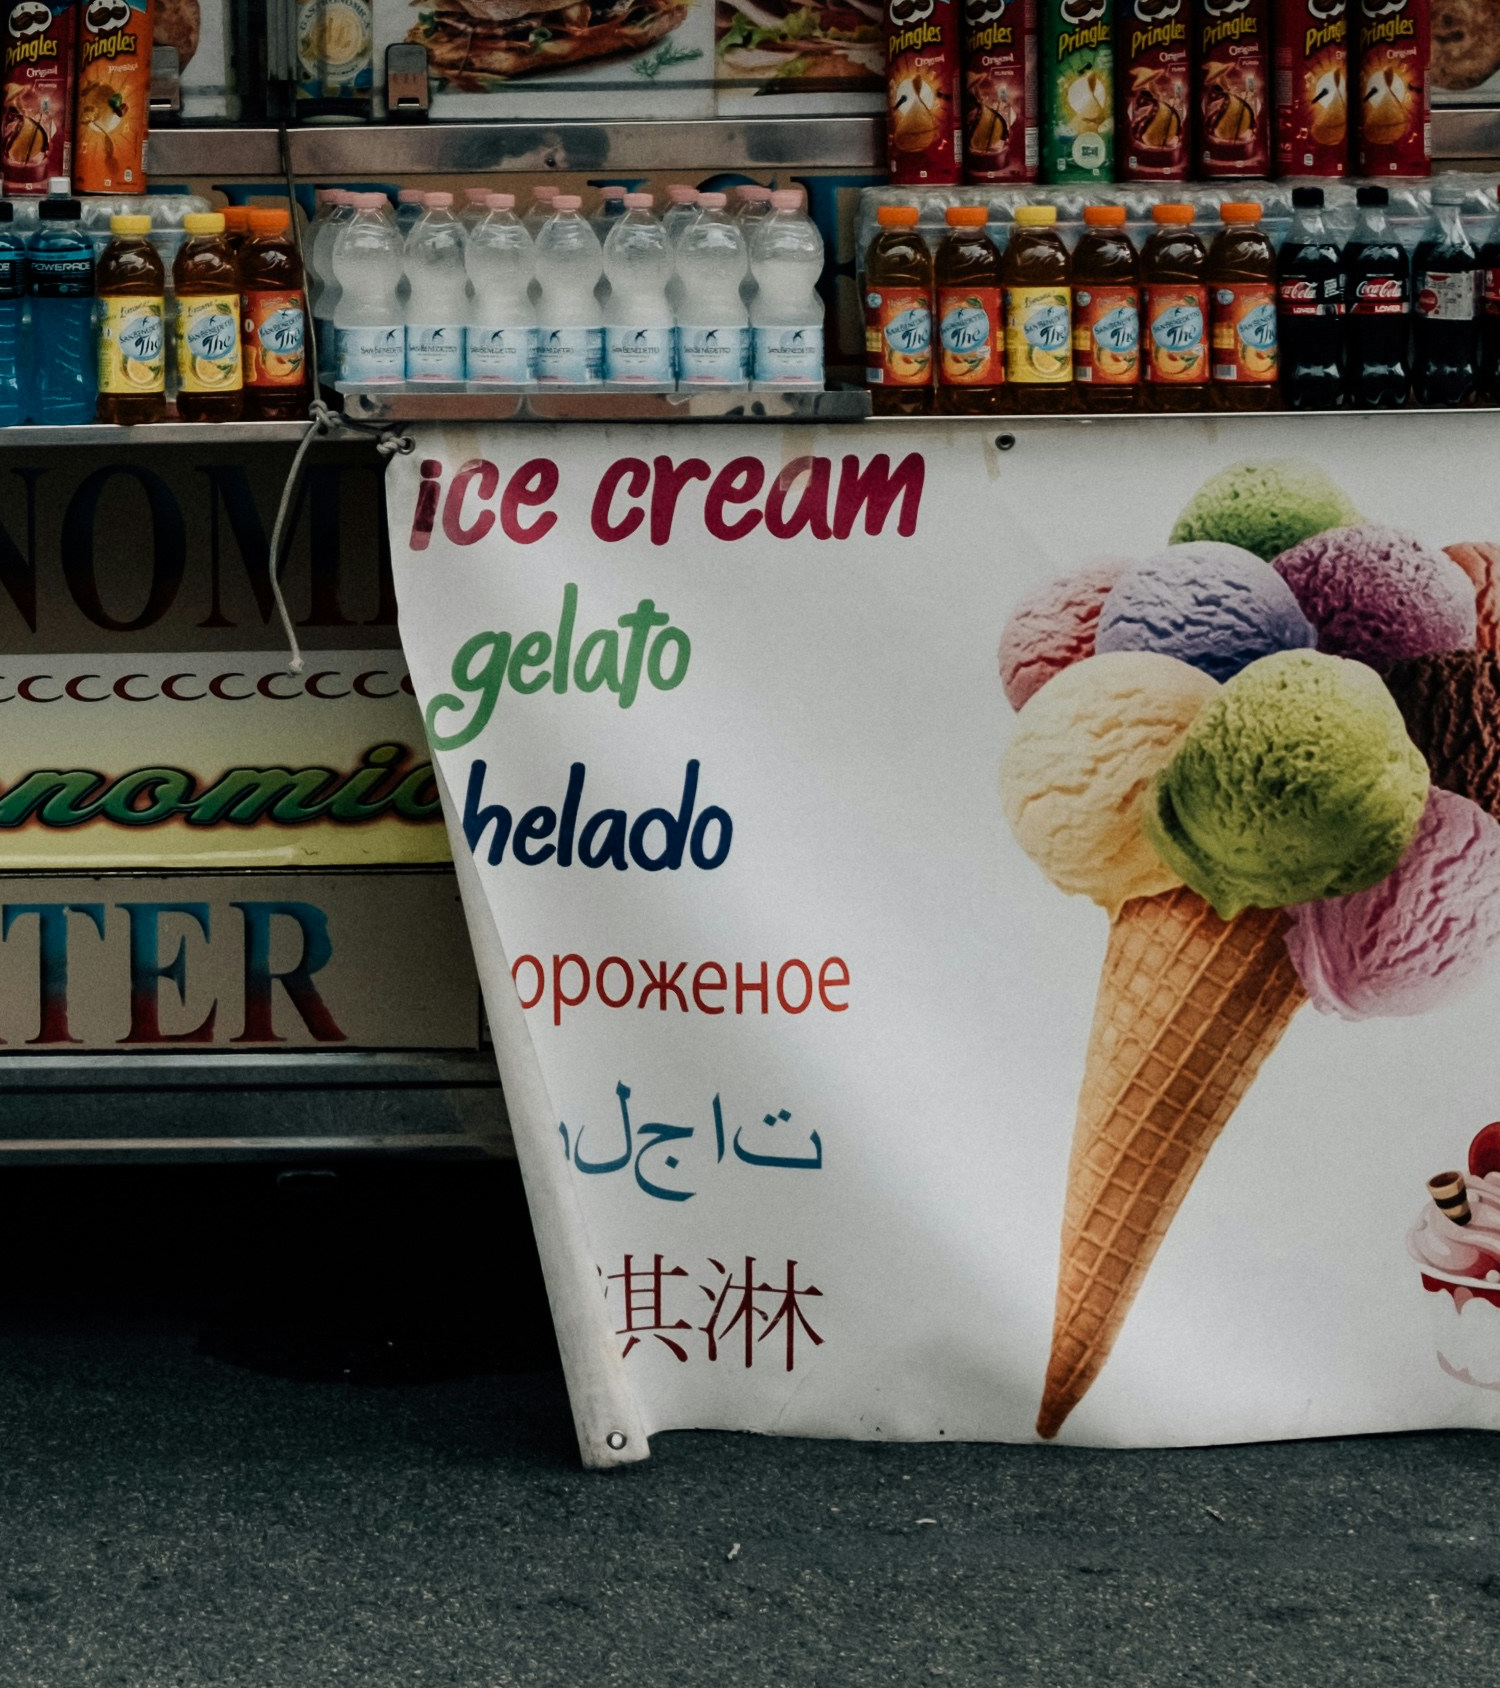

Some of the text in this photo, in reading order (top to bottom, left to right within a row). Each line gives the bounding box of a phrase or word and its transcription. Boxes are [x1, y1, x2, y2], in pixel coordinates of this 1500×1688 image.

[81, 30, 137, 67] Pringles
[888, 21, 942, 60] Pringles
[966, 21, 1013, 52] ringles
[1131, 18, 1186, 60] Pringles
[1202, 12, 1257, 54] Pringles
[1359, 15, 1414, 53] Pringles
[4, 34, 58, 73] Pringles
[31, 261, 92, 272] POWERADE
[1356, 279, 1404, 299] Coca-Cola
[1375, 304, 1401, 314] LOVER
[406, 450, 926, 552] ice cream
[425, 582, 692, 754] gelato
[462, 758, 733, 874] helado
